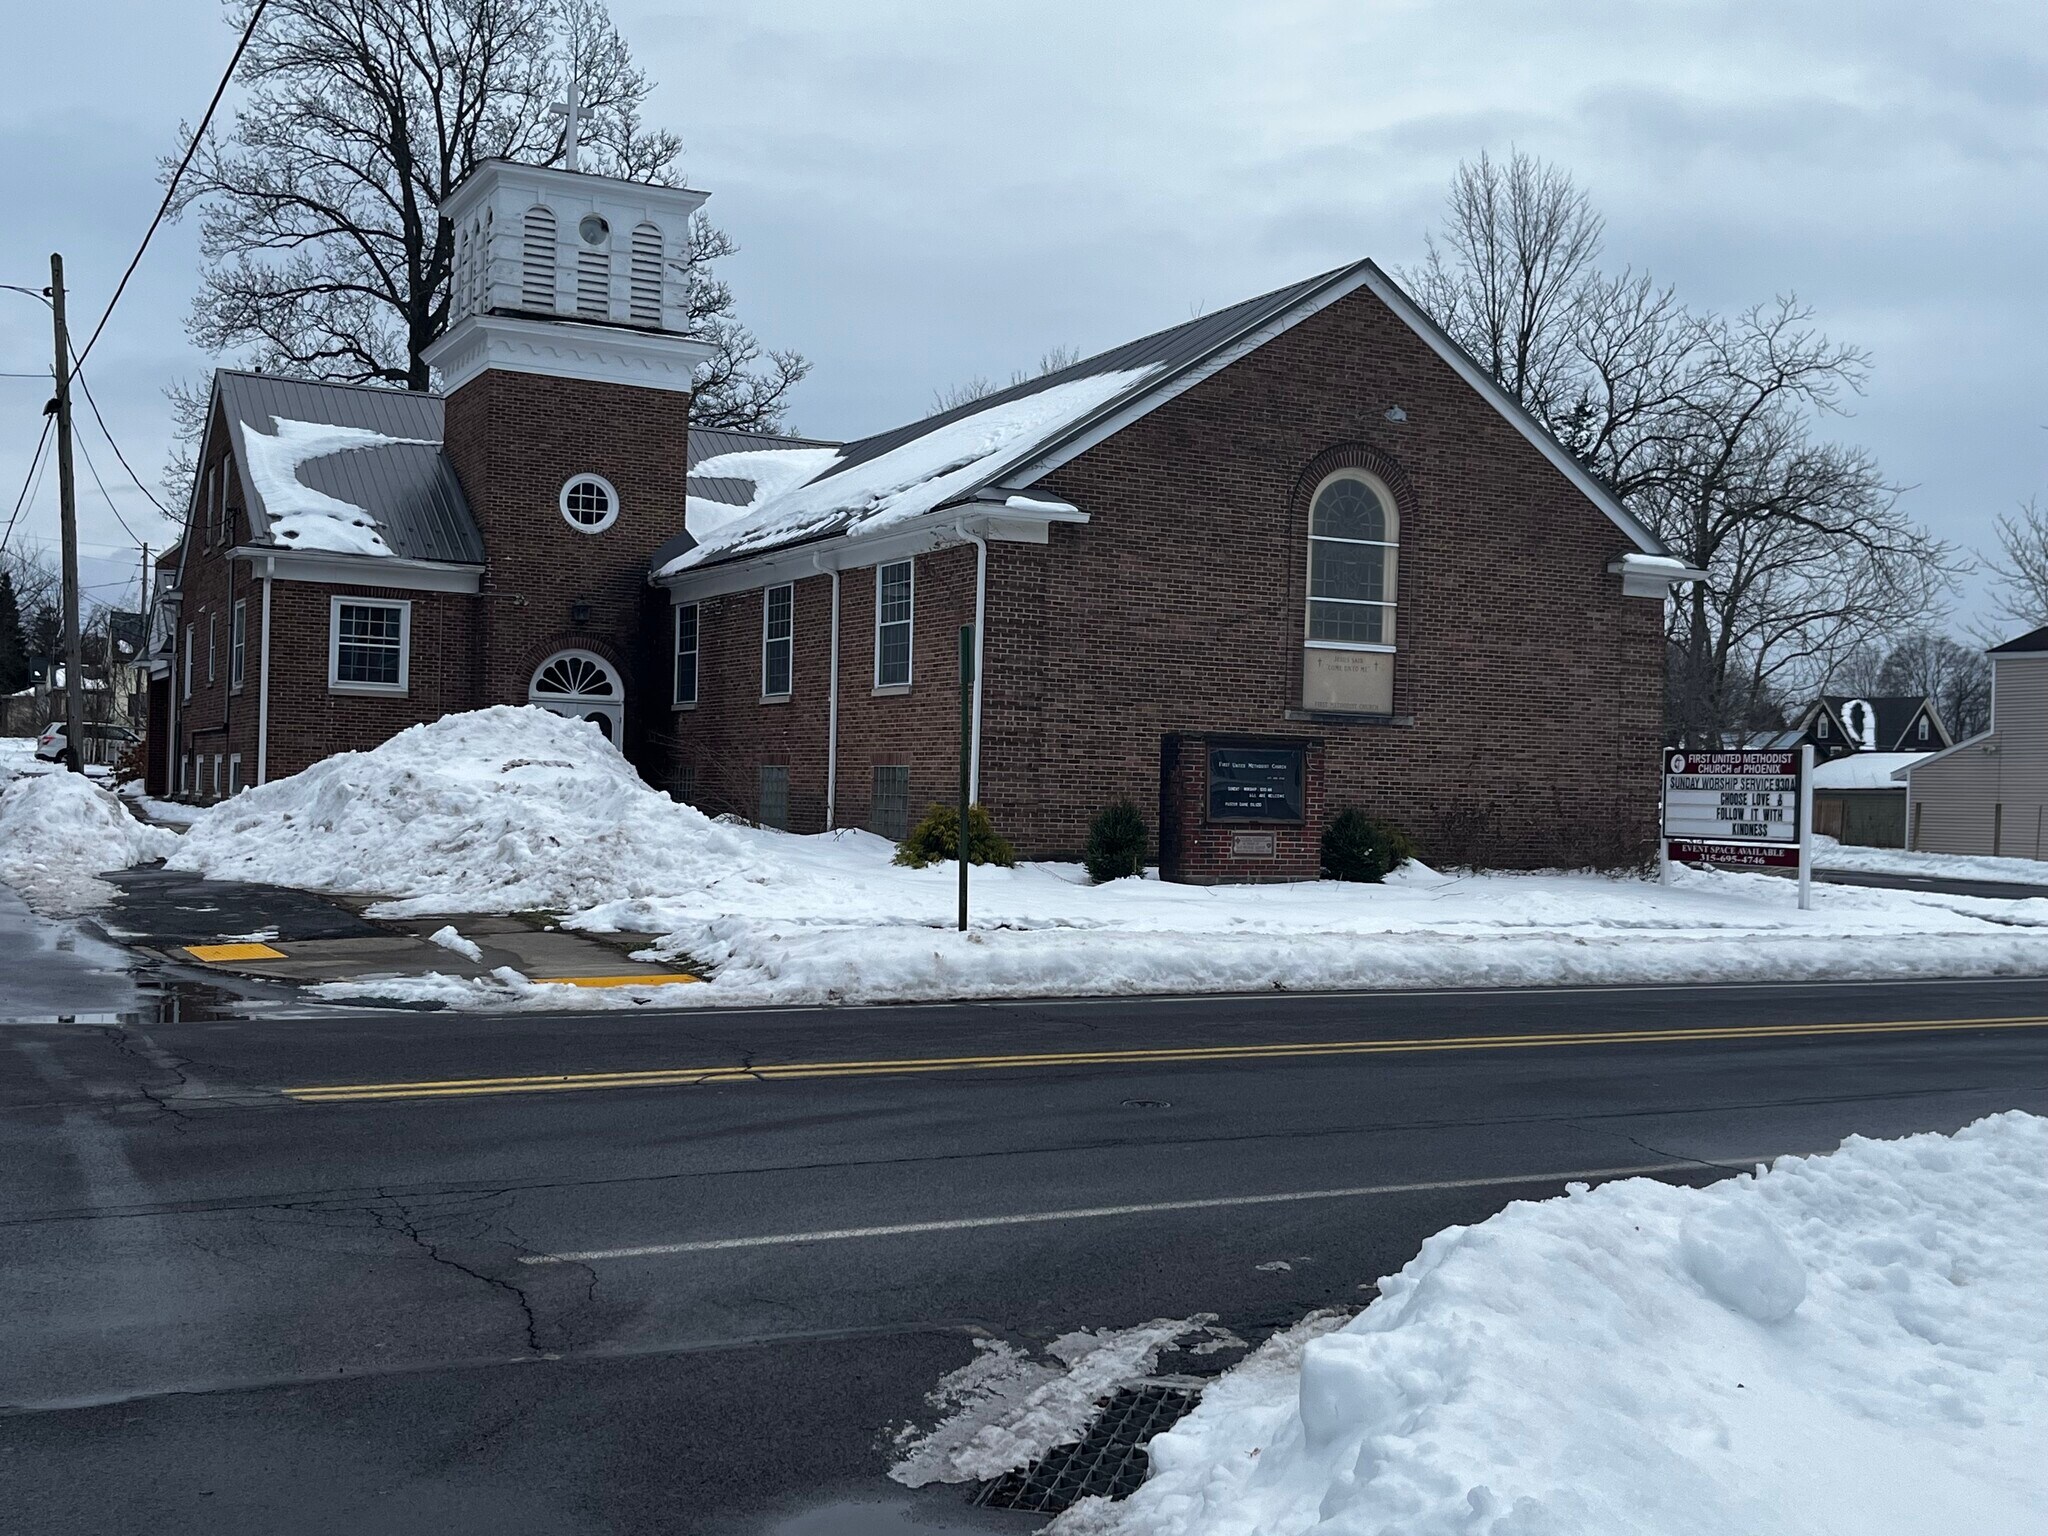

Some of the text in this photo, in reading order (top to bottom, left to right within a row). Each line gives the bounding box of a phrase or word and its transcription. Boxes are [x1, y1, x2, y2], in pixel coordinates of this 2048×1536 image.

[1688, 754, 1793, 764] FIRST UNITED METHODIST
[1698, 764, 1781, 774] CHURCH of PHOENIX
[1670, 776, 1700, 790] SUNDAY
[1702, 777, 1738, 790] WORSHIP
[1741, 778, 1774, 791] SERVICE
[1720, 792, 1747, 806] CHOOSE
[1752, 793, 1770, 806] LOVE
[1716, 807, 1783, 821] FOLLOW IT WITH
[1731, 823, 1768, 837] KINDNESS
[1681, 844, 1785, 857] EVENT SPACE AVAILABLE
[1699, 854, 1765, 864] 315-695-4746
